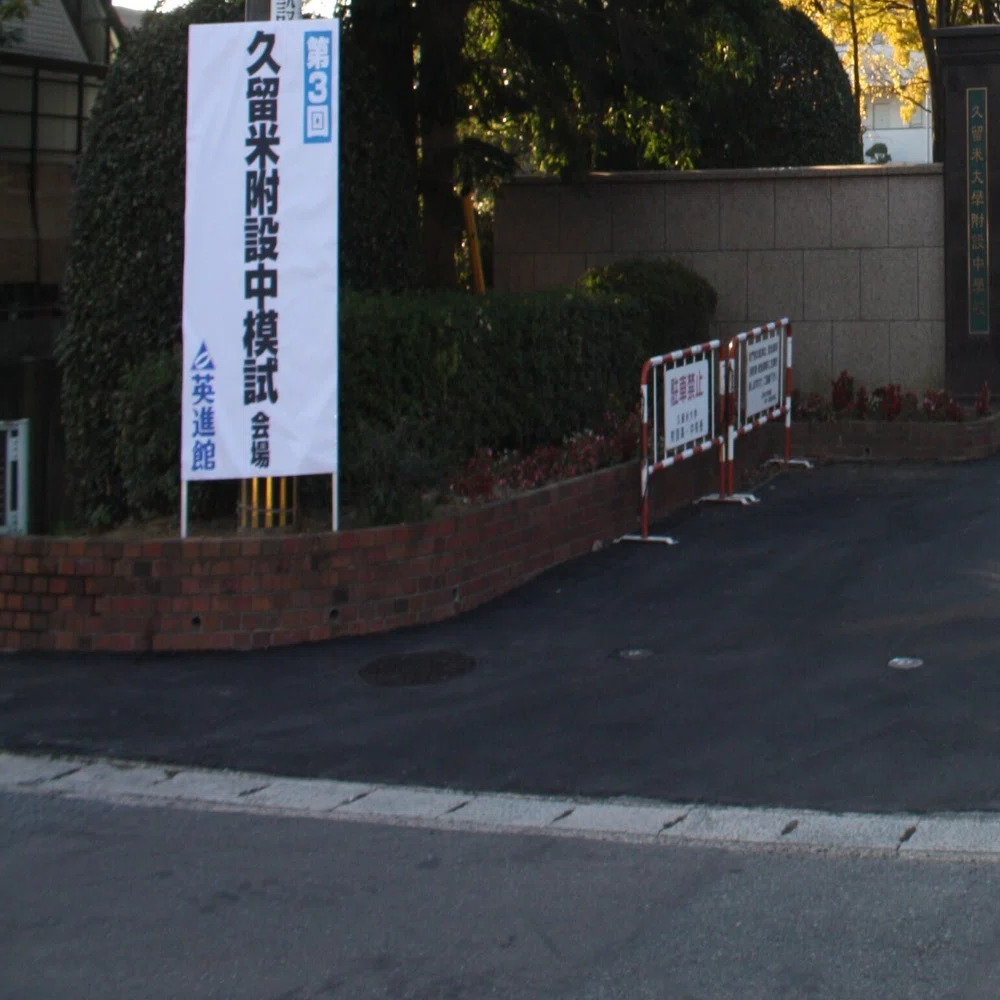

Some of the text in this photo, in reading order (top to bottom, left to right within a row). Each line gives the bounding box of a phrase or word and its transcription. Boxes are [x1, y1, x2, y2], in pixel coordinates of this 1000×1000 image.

[306, 35, 330, 138] 第3回
[243, 30, 281, 469] 久留米附設中模試 会場
[190, 373, 216, 471] 英進館
